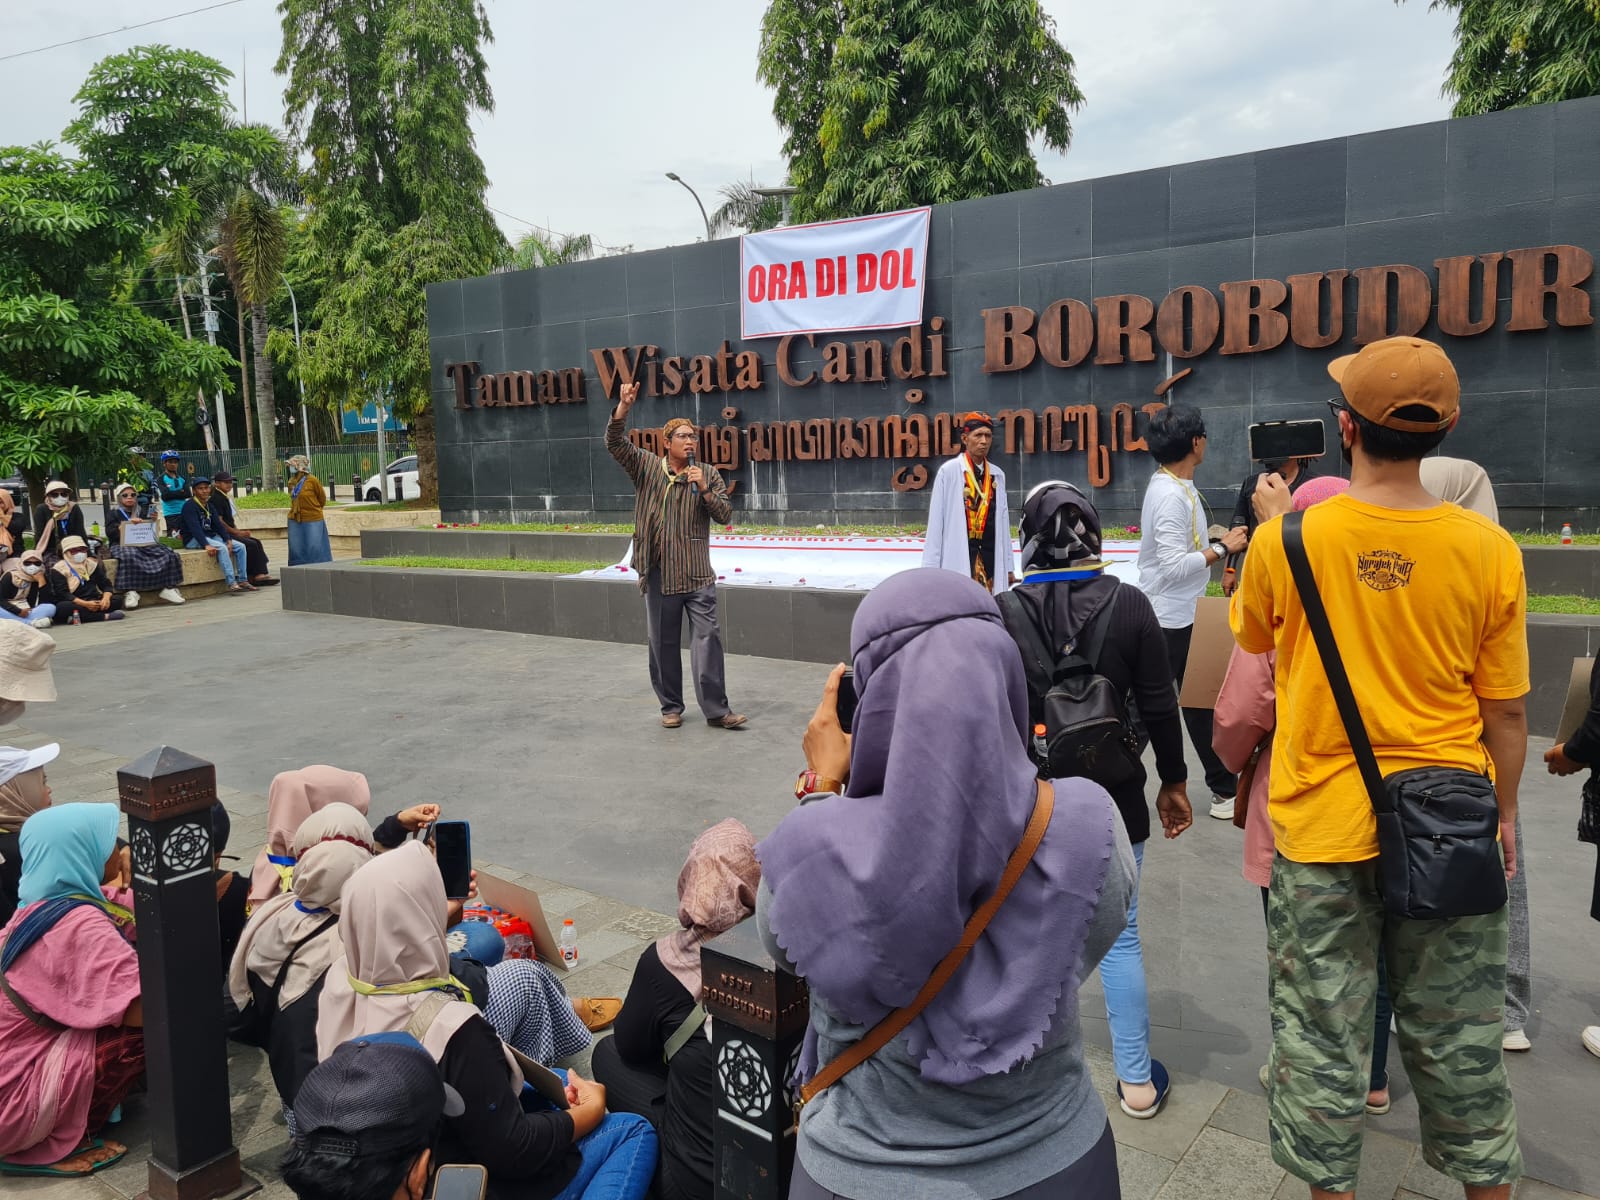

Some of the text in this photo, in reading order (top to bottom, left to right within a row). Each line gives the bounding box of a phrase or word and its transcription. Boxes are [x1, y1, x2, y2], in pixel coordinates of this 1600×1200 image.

[445, 244, 1594, 411] Taman Wisata Candi BOROBUDUR
[747, 247, 917, 304] ORA DI DOL
